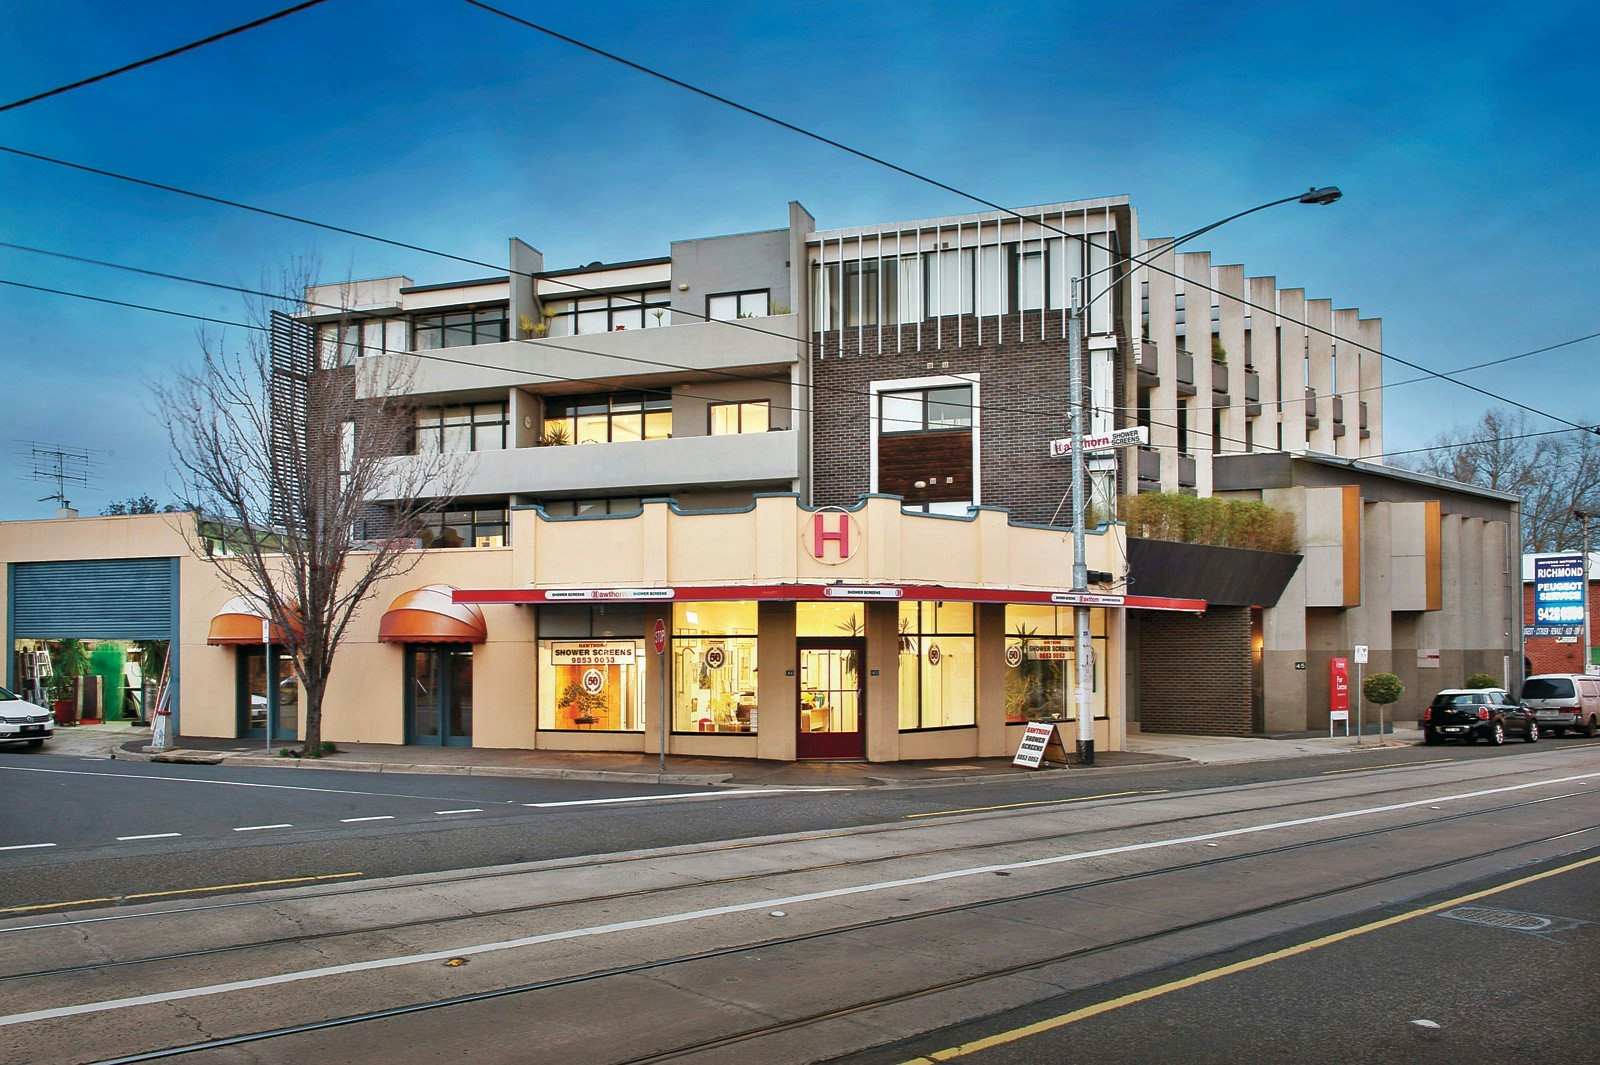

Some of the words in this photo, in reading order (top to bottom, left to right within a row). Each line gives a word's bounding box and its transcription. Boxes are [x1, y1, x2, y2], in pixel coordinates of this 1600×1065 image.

[1112, 430, 1139, 440] SHOWER
[1055, 437, 1109, 452] Hahorn
[1111, 436, 1140, 445] SCREENS
[814, 514, 849, 558] H
[1537, 567, 1583, 578] RICHMOND
[1537, 582, 1583, 591] PEUGEOT
[655, 630, 665, 643] STOP
[709, 652, 721, 662] 50
[1008, 650, 1018, 659] 50
[587, 676, 599, 686] 50
[1025, 735, 1046, 744] SHOWER
[1021, 743, 1043, 752] SCREENS
